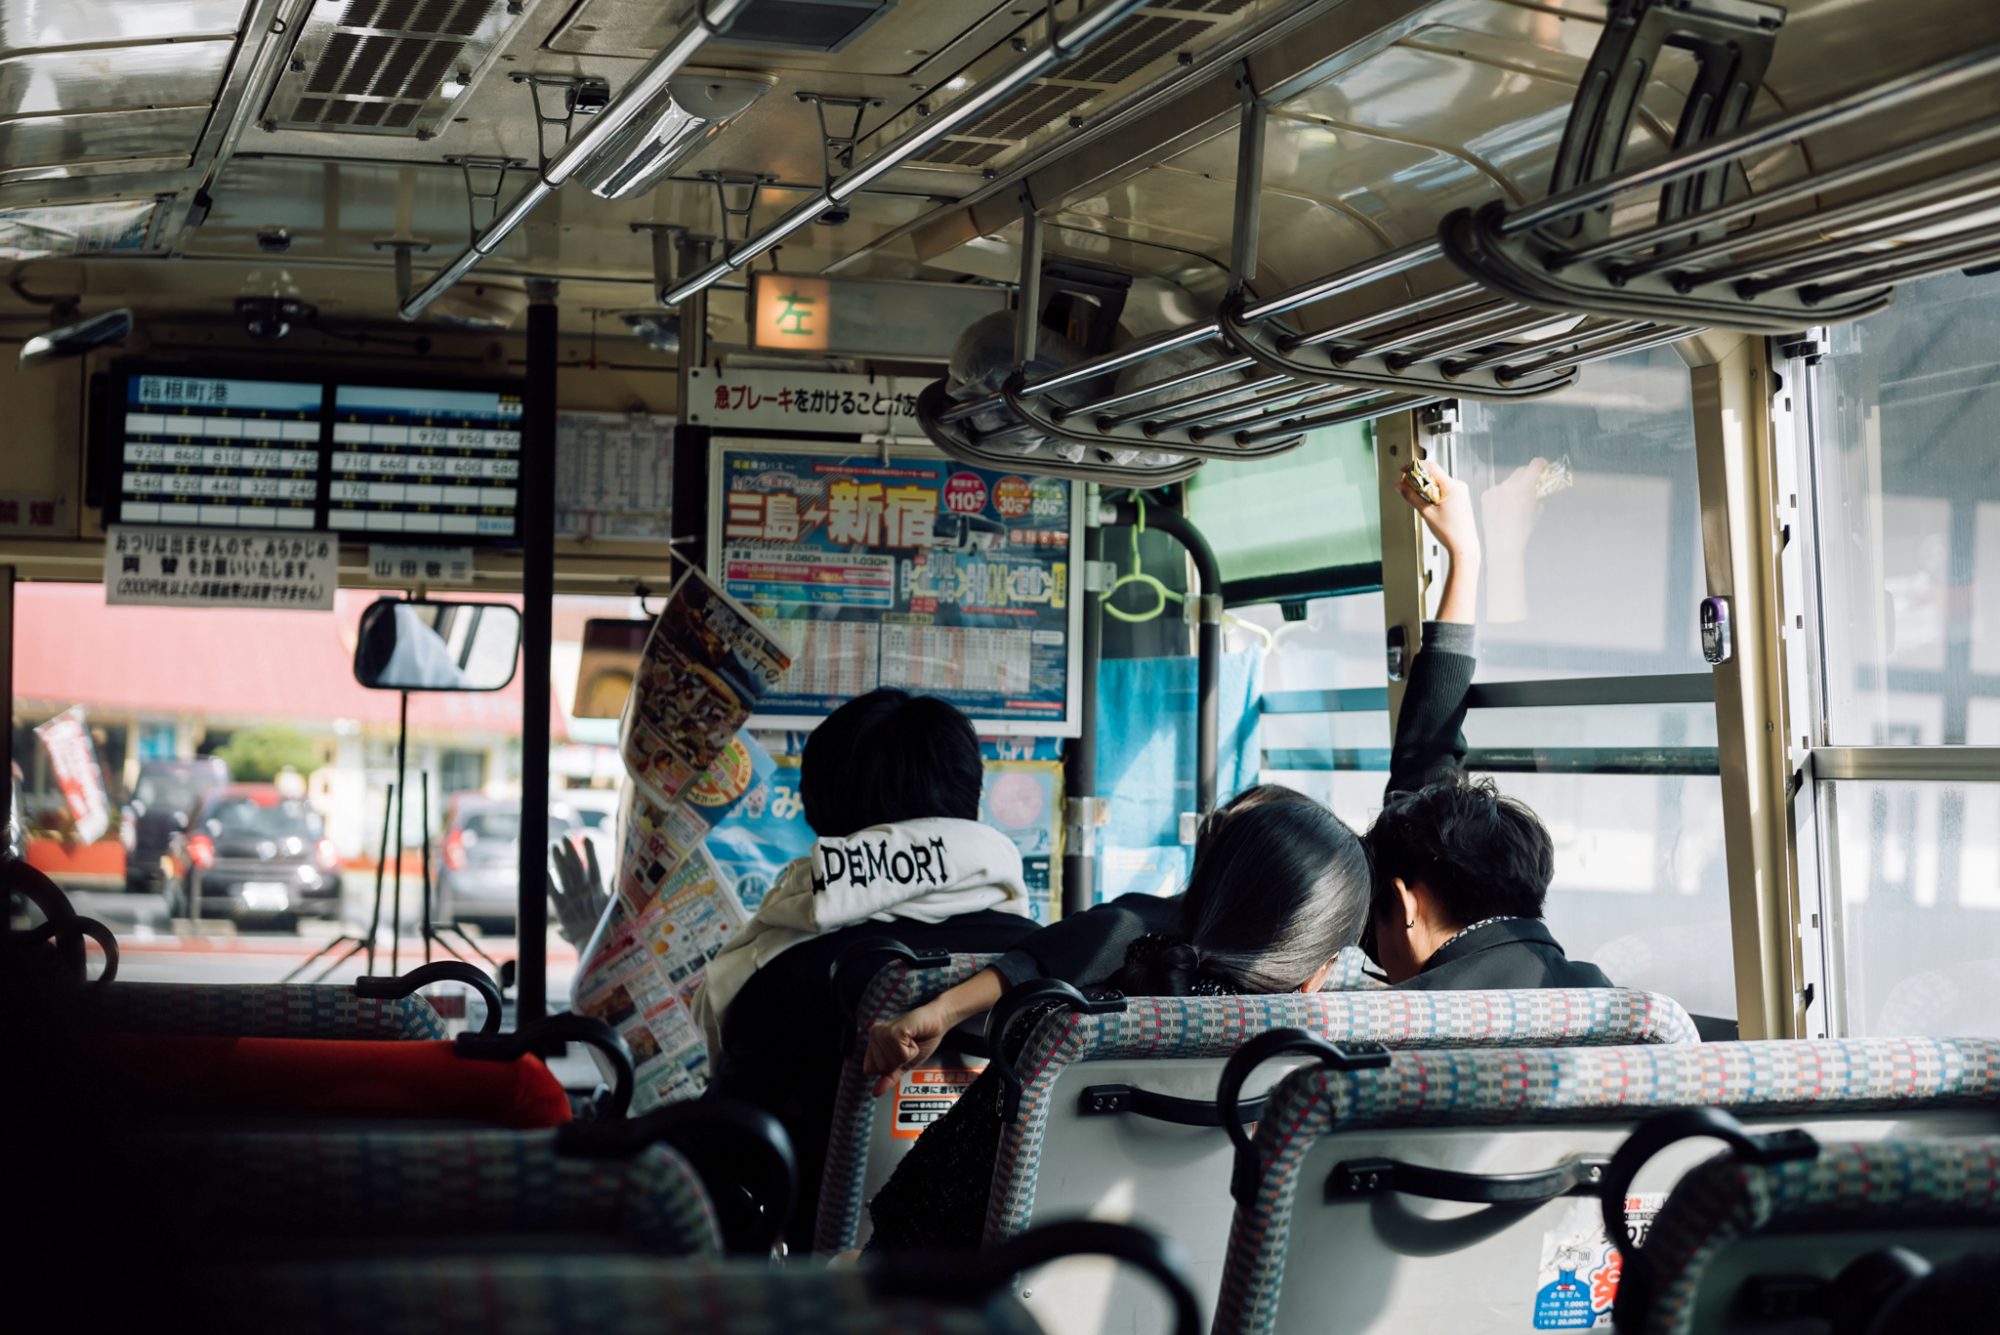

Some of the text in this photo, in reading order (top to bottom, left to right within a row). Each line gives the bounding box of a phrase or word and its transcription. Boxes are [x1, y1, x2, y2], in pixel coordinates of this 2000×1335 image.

[775, 291, 816, 336] 左
[142, 380, 229, 402] 箱根町港
[726, 479, 939, 550] 三島 新宿
